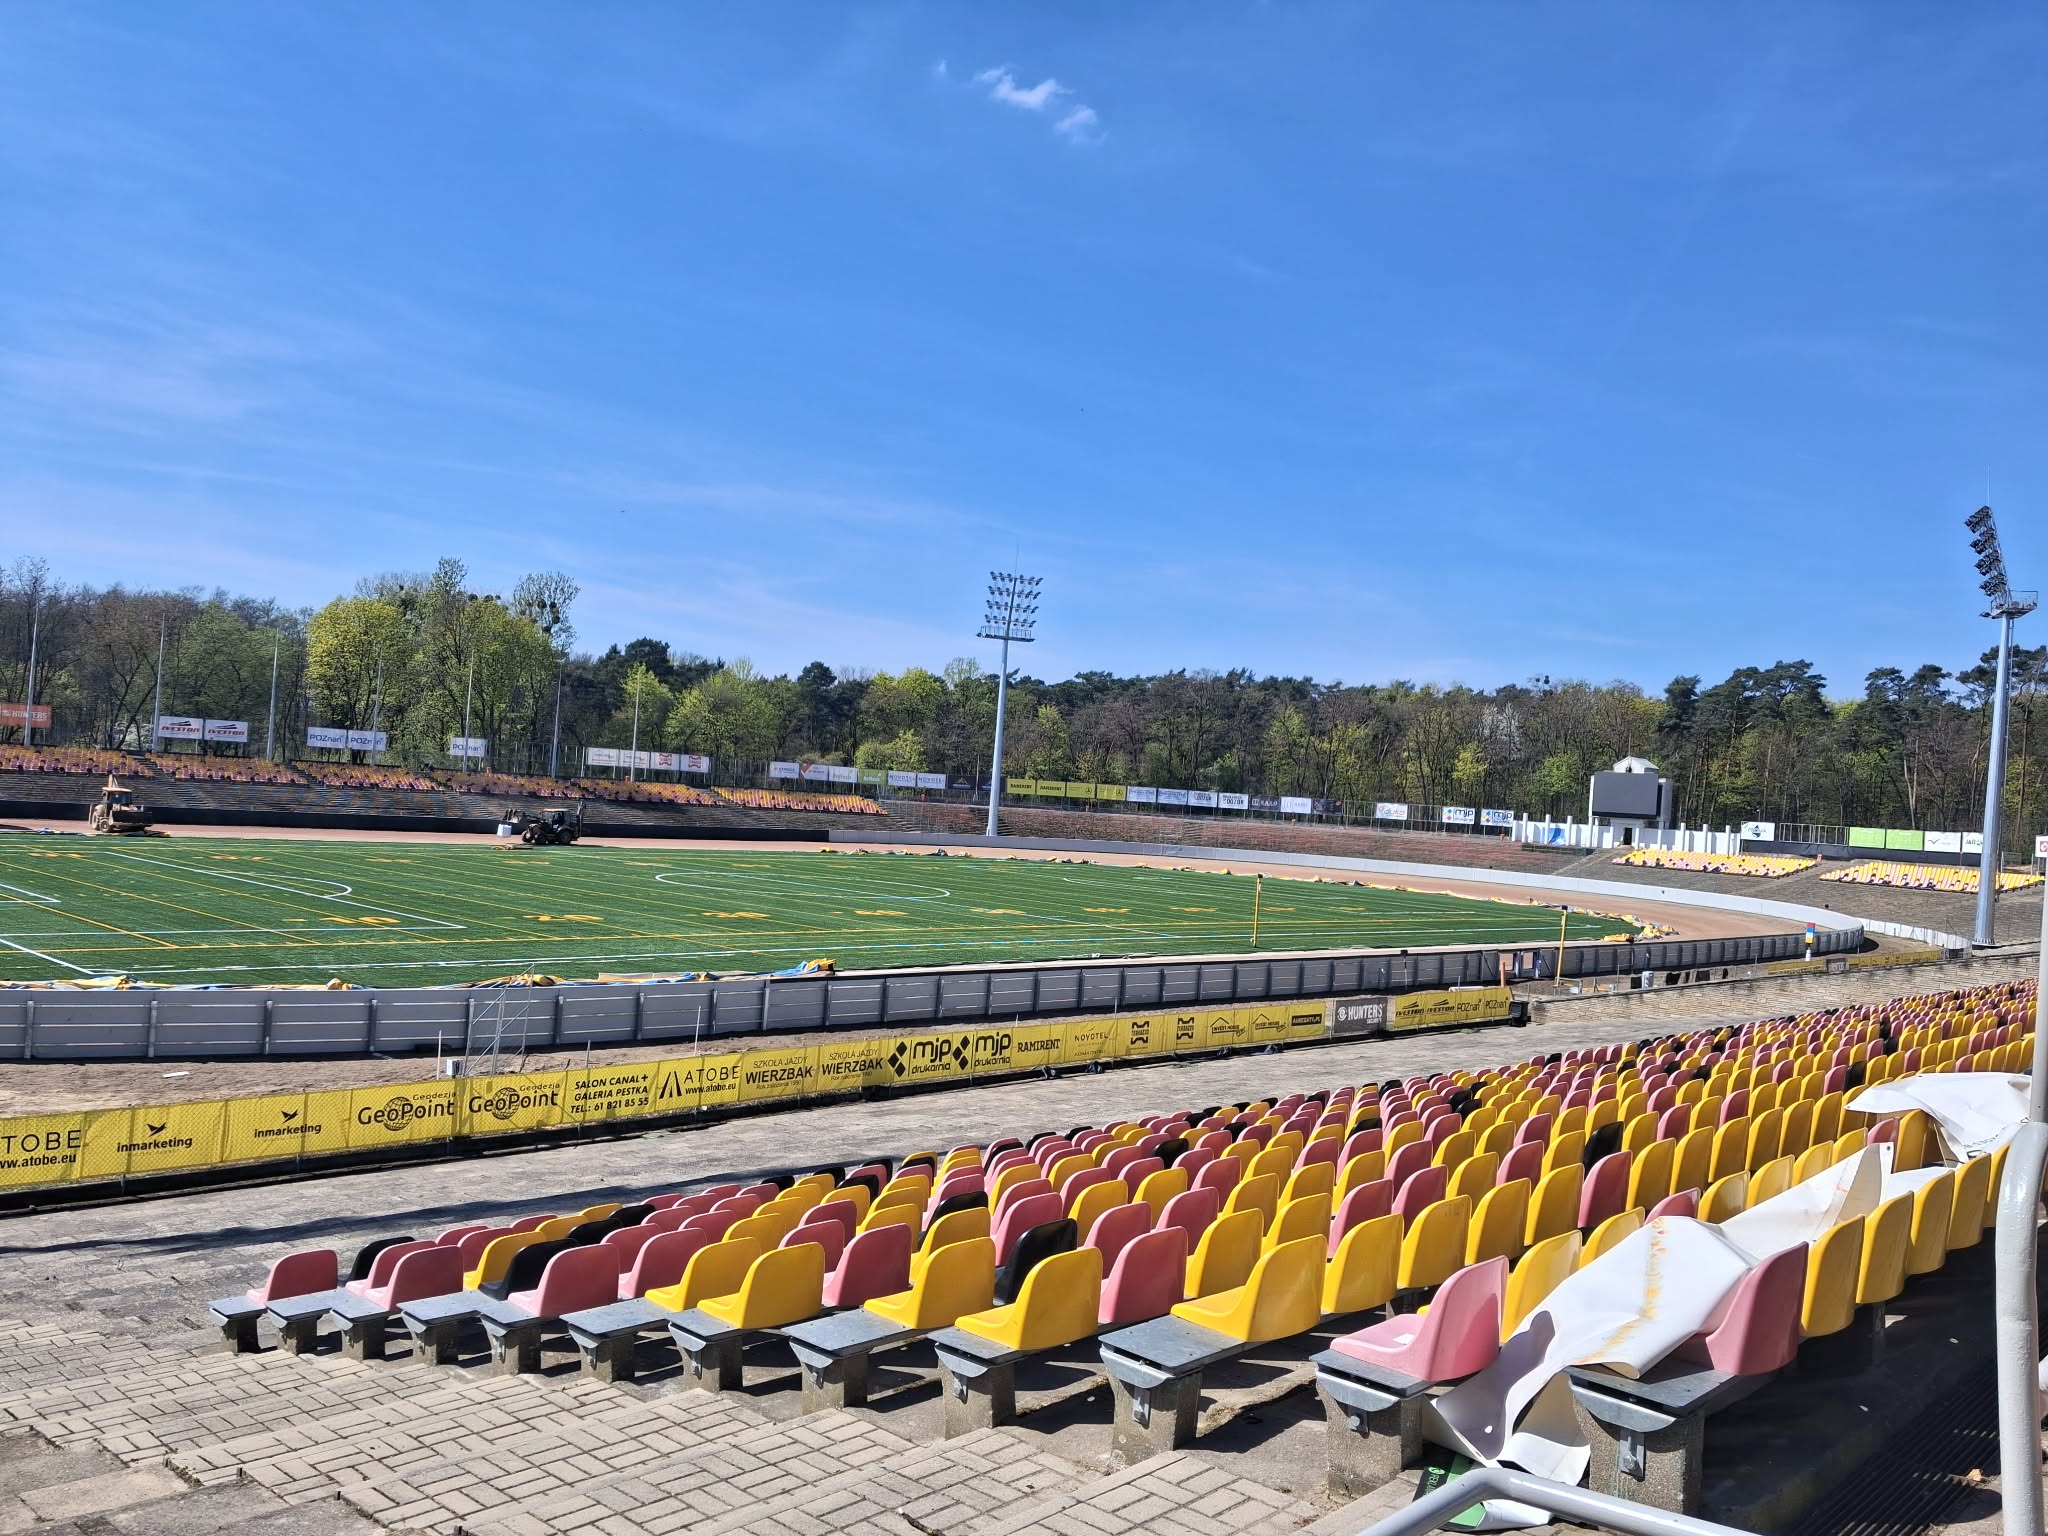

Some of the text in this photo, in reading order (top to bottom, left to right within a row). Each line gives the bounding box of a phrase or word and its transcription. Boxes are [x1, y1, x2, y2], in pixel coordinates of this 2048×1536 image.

[1347, 1003, 1383, 1021] HUNTERS
[975, 1031, 1012, 1057] mjp
[1074, 1031, 1109, 1043] NOVOTEL
[912, 1037, 952, 1063] mjp
[1017, 1038, 1061, 1053] RAMIRENT
[784, 1055, 808, 1066] JAZDY
[821, 1057, 884, 1076] WIERZBAK
[911, 1062, 951, 1074] drukarnia
[974, 1056, 1010, 1067] drukarnia
[683, 1065, 740, 1085] ATOBE
[745, 1065, 813, 1085] WIERZBAK
[519, 1083, 560, 1092] Geodezja
[574, 1078, 607, 1090] SALON
[685, 1082, 737, 1095] www.atobe.eu
[412, 1092, 456, 1101] Geodezja
[574, 1085, 648, 1102] GALERIA PESTKA
[468, 1090, 559, 1114] GeoPoint
[594, 1102, 604, 1111] 61
[606, 1100, 622, 1110] 821
[624, 1098, 635, 1108] 85
[637, 1097, 649, 1106] 55
[357, 1100, 455, 1125] GeoPoint
[254, 1123, 322, 1139] inmarketing
[0, 1129, 82, 1154] TOBE
[116, 1137, 193, 1153] inmarketing
